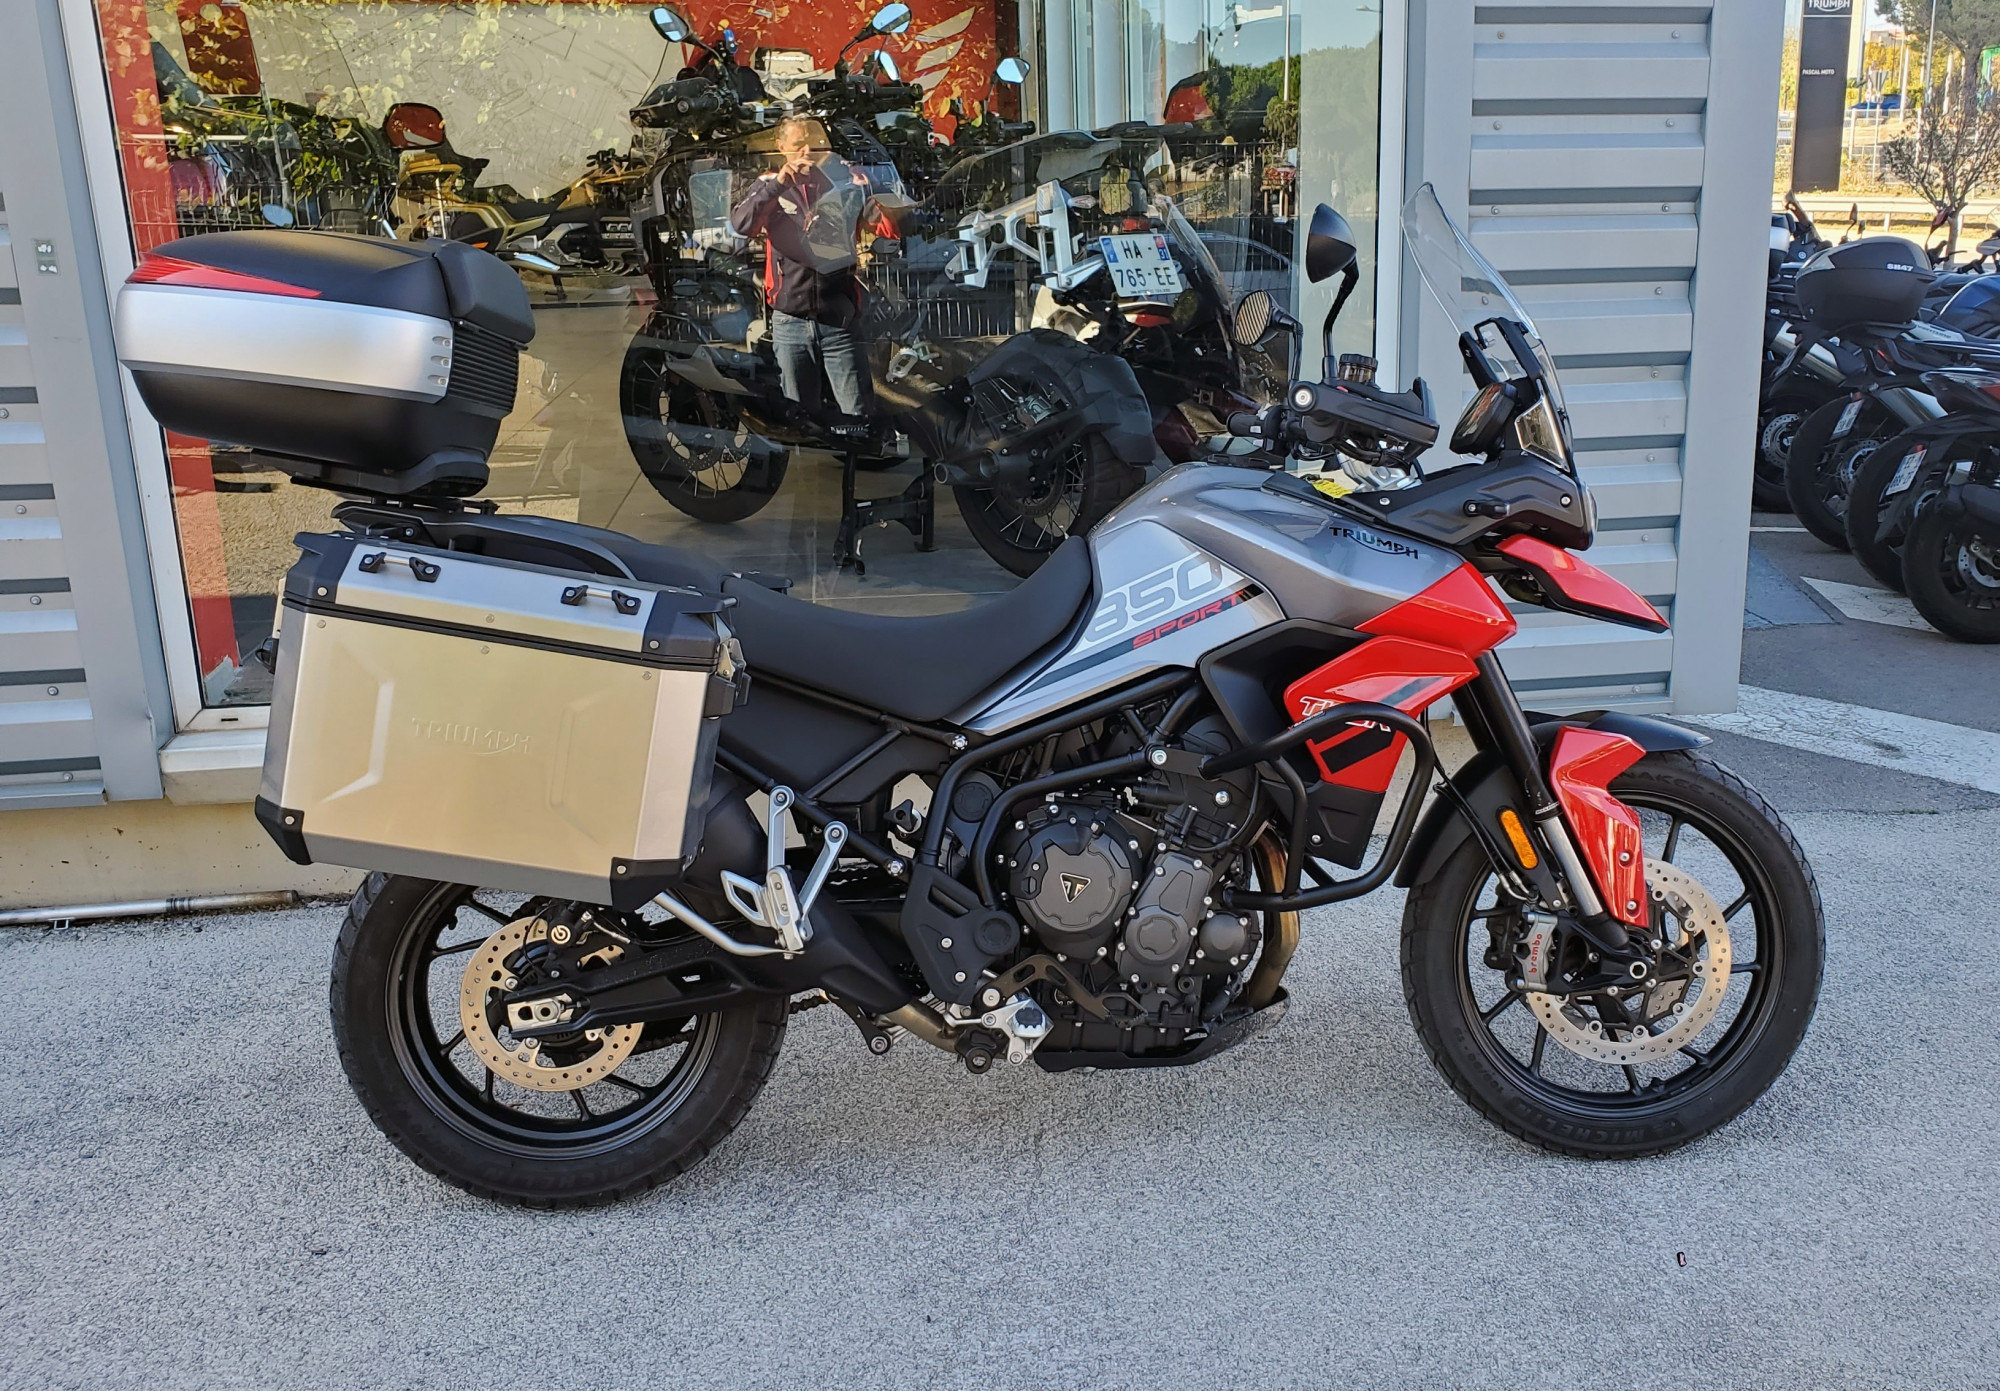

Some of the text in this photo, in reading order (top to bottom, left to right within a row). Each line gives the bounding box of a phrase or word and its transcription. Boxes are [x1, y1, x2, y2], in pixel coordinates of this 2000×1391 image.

[1808, 0, 1850, 10] TRIUMPH
[1328, 526, 1419, 560] TRIUMPH
[1087, 555, 1223, 641] 850
[1132, 589, 1244, 650] SPORT
[411, 716, 531, 755] TRIUMPH
[1528, 933, 1543, 974] brembo
